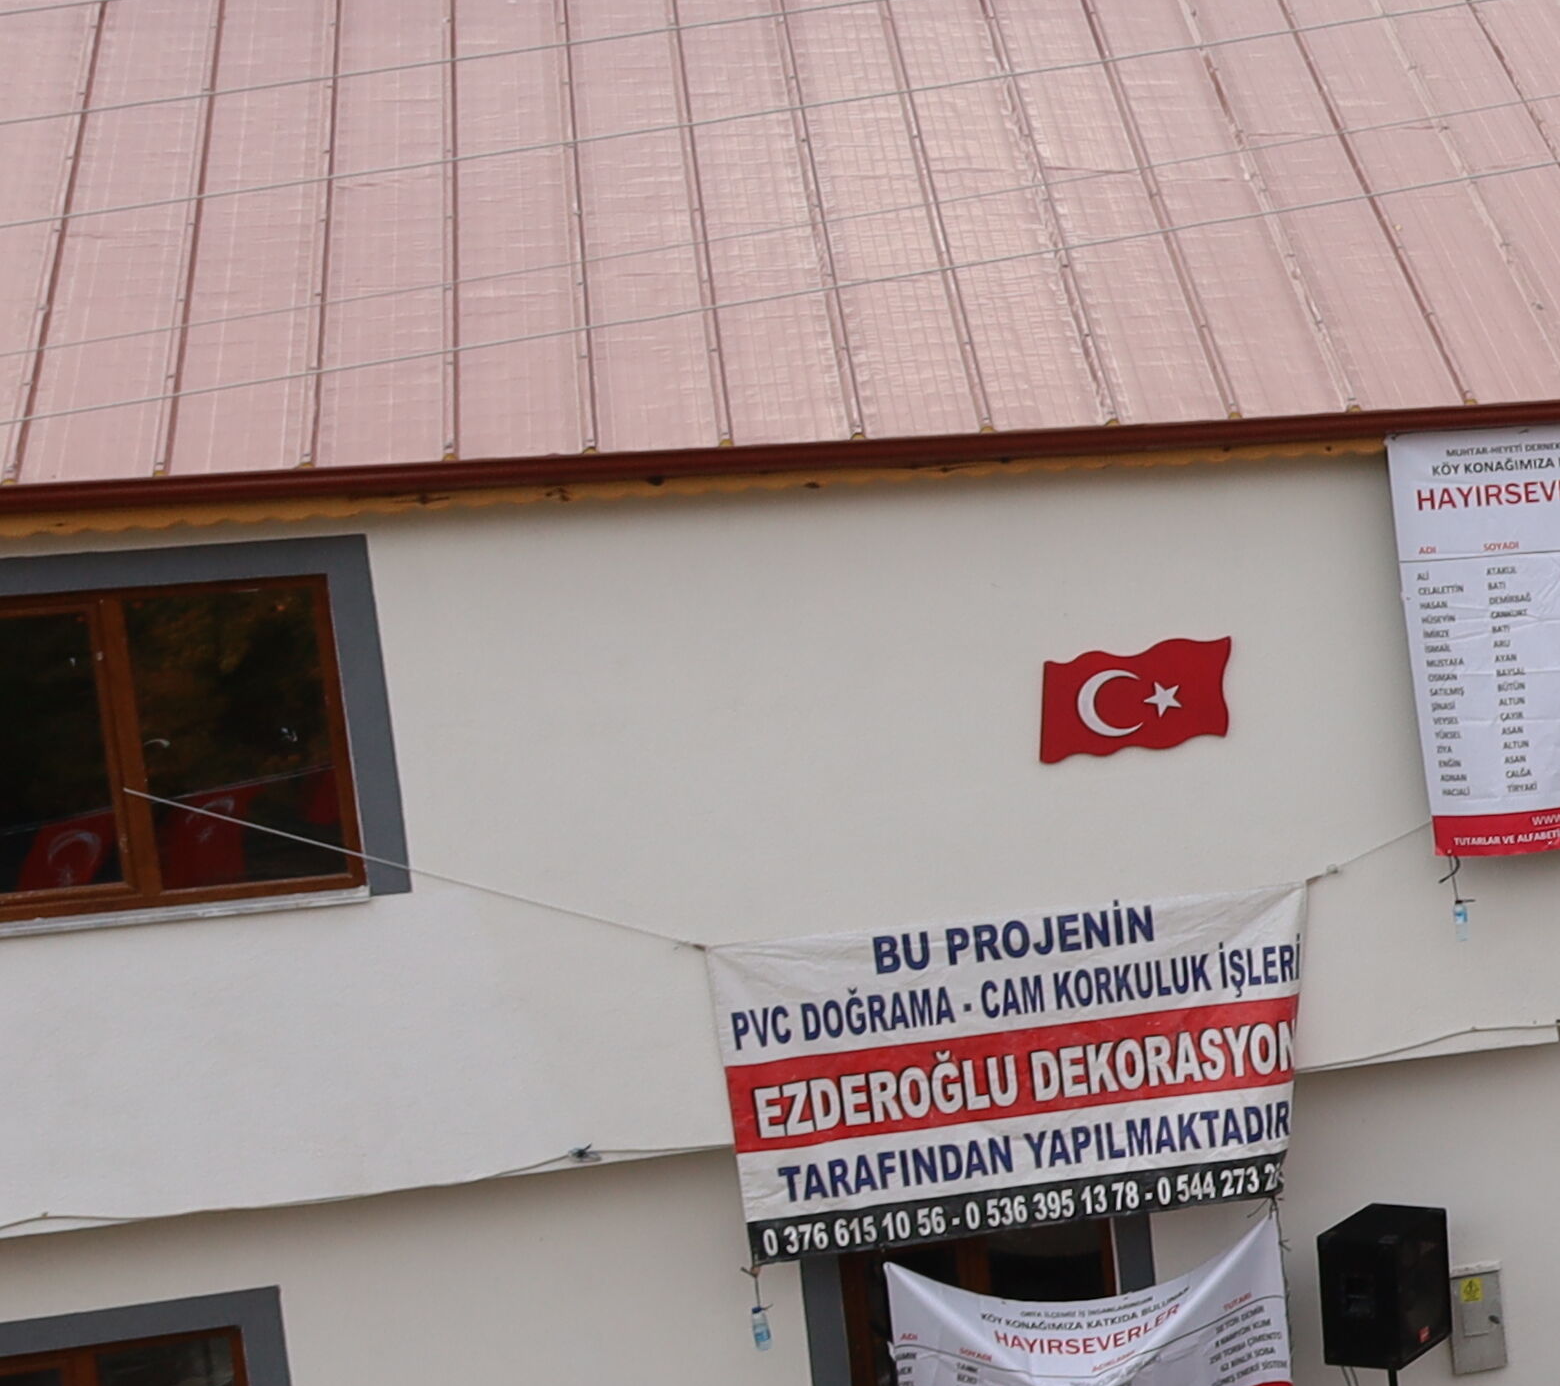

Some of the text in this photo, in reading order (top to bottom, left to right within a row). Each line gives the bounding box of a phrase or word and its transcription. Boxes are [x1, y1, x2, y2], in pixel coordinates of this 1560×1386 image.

[1432, 462, 1460, 476] KÖY
[1464, 457, 1555, 474] KONAĞIMIZA
[1419, 547, 1436, 555] ADI
[1483, 541, 1519, 552] SOYADI
[1418, 584, 1464, 595] CELALETTİN
[1488, 582, 1505, 590] BATI
[1420, 600, 1448, 609] HASAN
[1421, 615, 1456, 624] HÜSEYİN
[1426, 654, 1517, 667] MUSTAFA AYAN
[1428, 673, 1457, 682] OSMAN
[1499, 697, 1525, 706] ALTUN
[1502, 727, 1524, 735] ASAN
[1503, 741, 1529, 749] ALTUN
[1504, 755, 1526, 764] ASAN
[1453, 837, 1500, 846] TUTARLAR
[1502, 835, 1516, 844] VE
[872, 899, 1155, 974] BU PROJENİN
[731, 1005, 792, 1051] PVC
[800, 987, 956, 1041] DOĞRAMA
[981, 974, 1045, 1019] CAM
[1053, 953, 1212, 1011] KORKULUK
[1217, 933, 1301, 997] İŞLERİ
[753, 1020, 1296, 1139] EZDEROĞLU DEKORASYON
[777, 1100, 1290, 1203] TARAFINDAN YAPILMAKTADIR
[763, 1228, 778, 1256] 0
[783, 1222, 829, 1254] 376
[834, 1215, 878, 1248] 615
[881, 1211, 911, 1241] 10
[917, 1205, 946, 1237] 56
[965, 1201, 980, 1230] 0
[986, 1195, 1027, 1226] 536
[1032, 1189, 1075, 1225] 395
[1080, 1185, 1108, 1214] 13
[1112, 1181, 1140, 1211] 78
[1157, 1177, 1172, 1205] 0
[1176, 1171, 1216, 1203] 544
[1220, 1165, 1260, 1198] 273
[981, 1286, 1190, 1331] KÖY KONAĞIMIZA KATKIDA BULUNAN
[994, 1303, 1180, 1355] HAYIRSEVERLER
[900, 1333, 918, 1341] ADI
